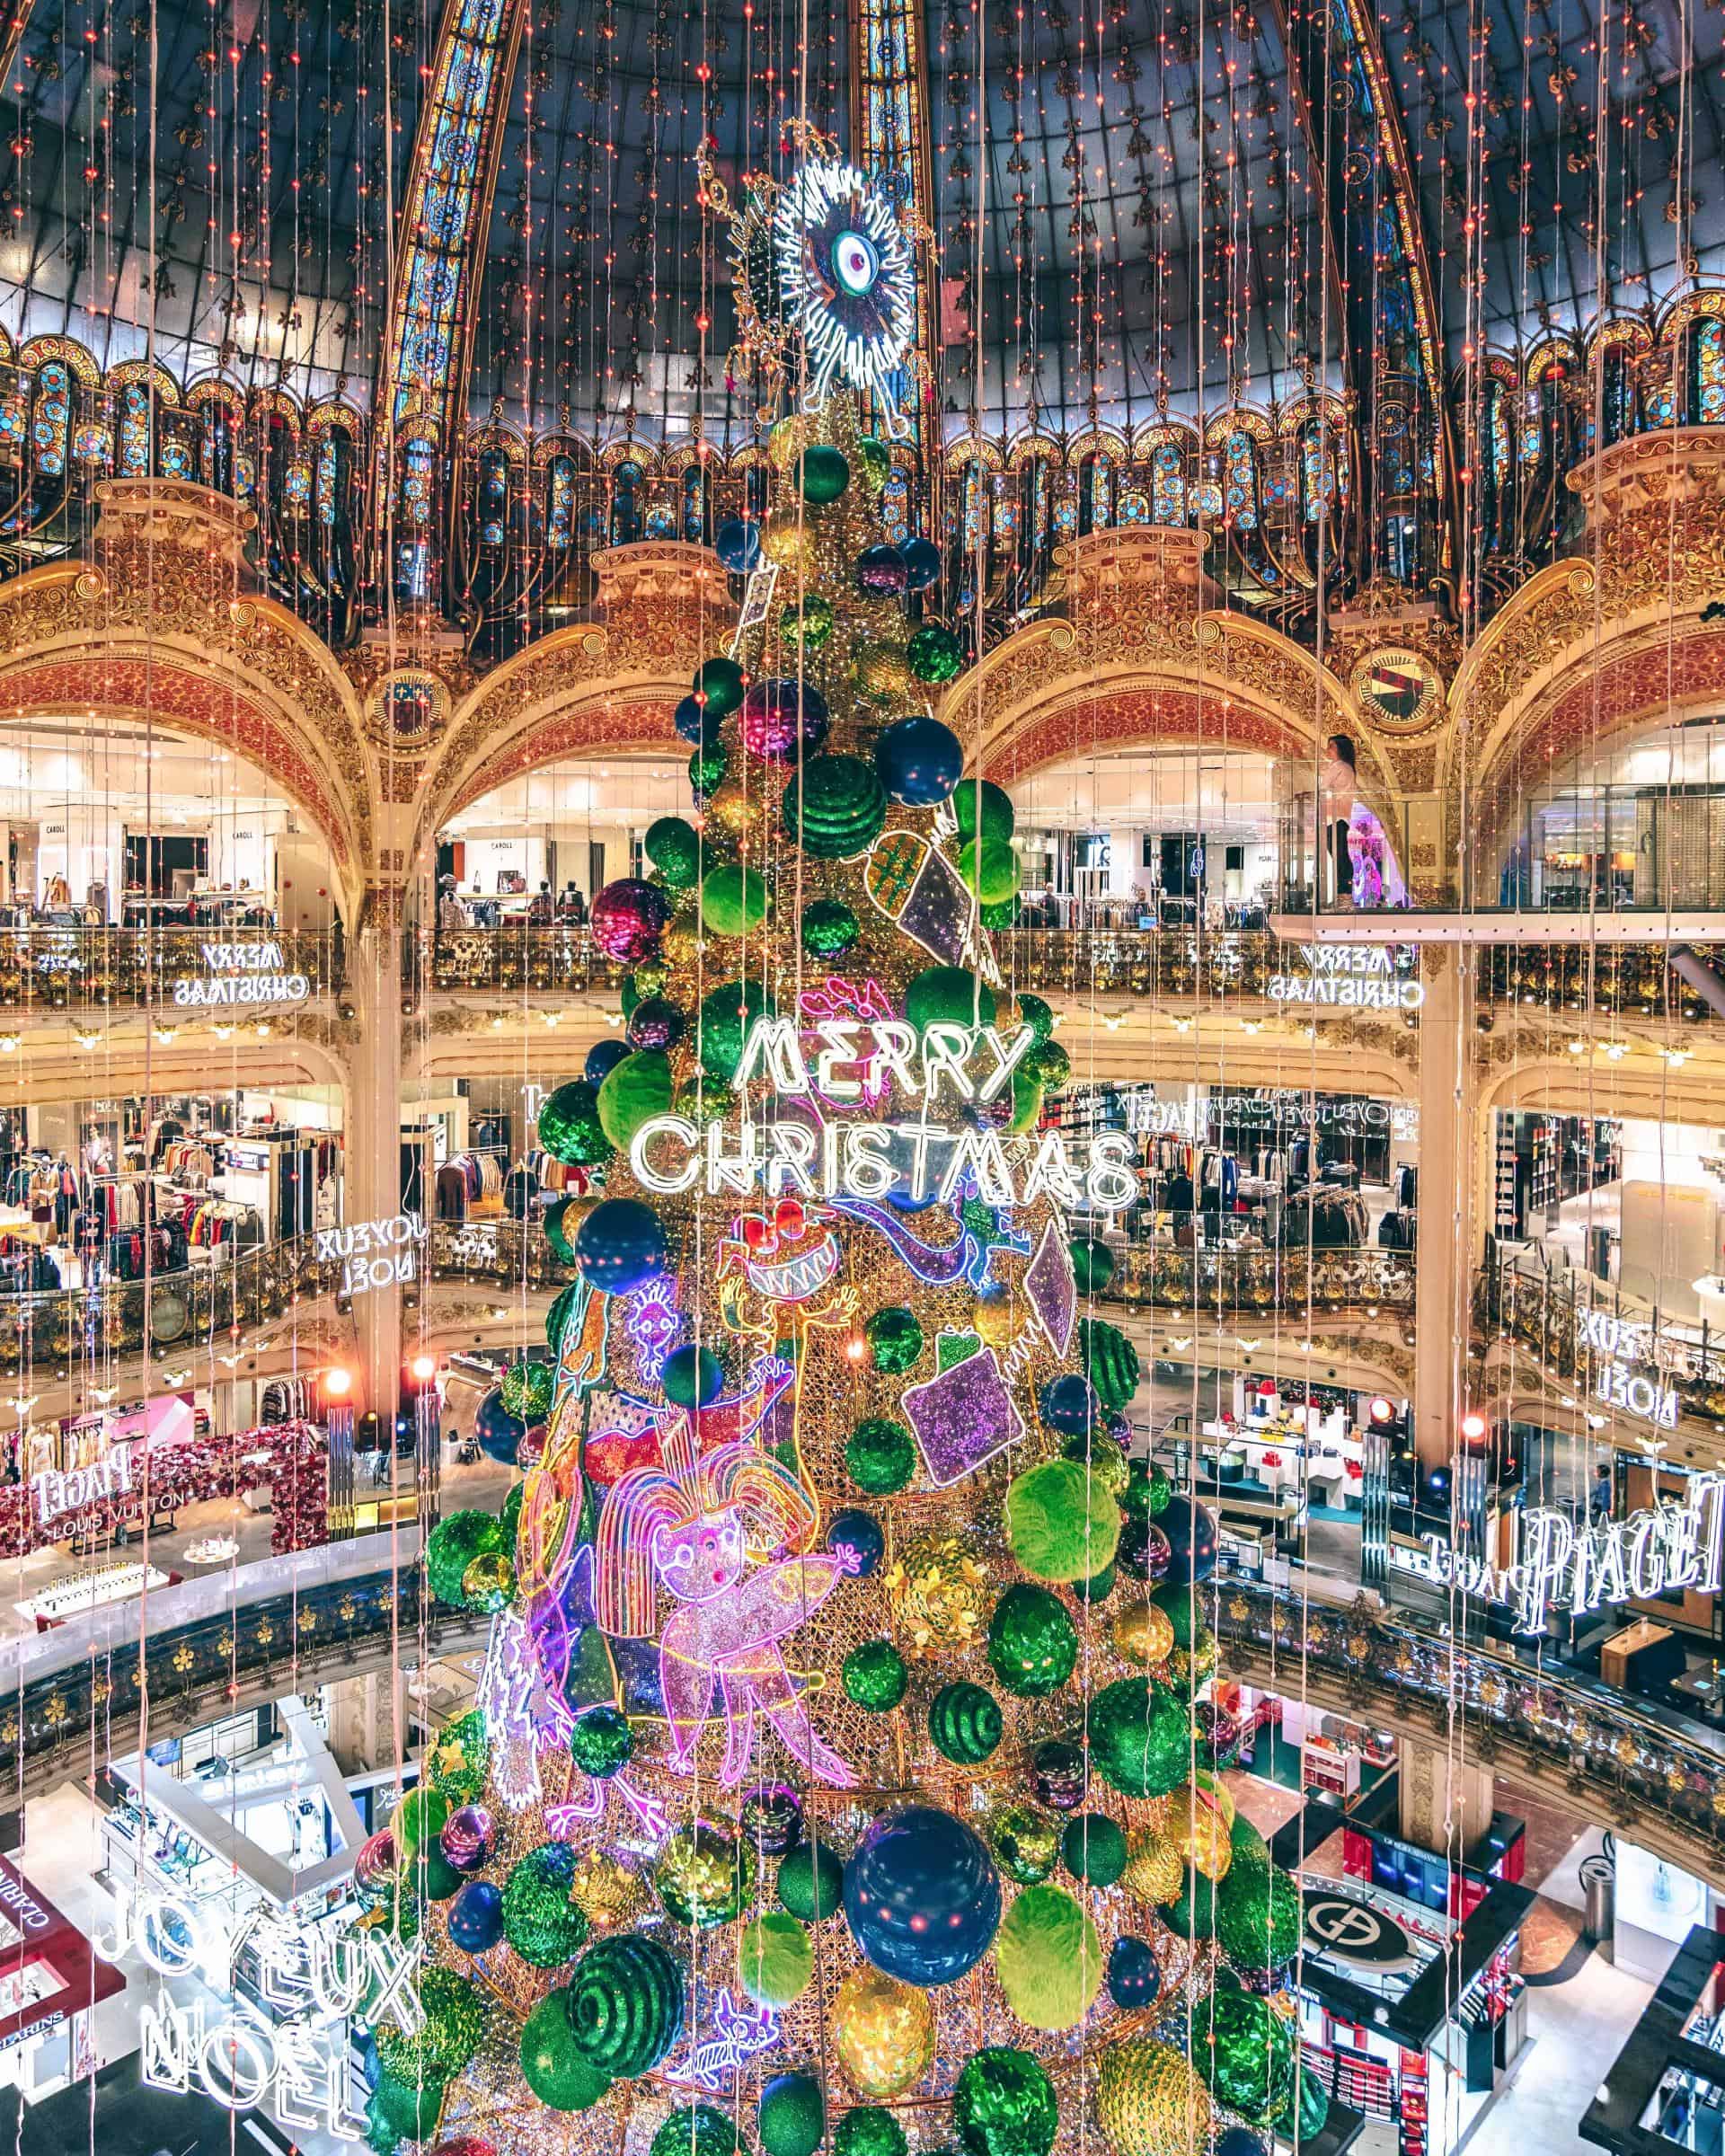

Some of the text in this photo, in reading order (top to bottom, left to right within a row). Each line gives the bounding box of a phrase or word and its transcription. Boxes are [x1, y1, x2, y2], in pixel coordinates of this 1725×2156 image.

[45, 825, 66, 834] CAROLL
[730, 1014, 1036, 1102] MERRY
[630, 1112, 1142, 1211] CHRISTMAS
[53, 1493, 185, 1541] LOUIS VUITTON
[1520, 1471, 1725, 1635] PIAGET
